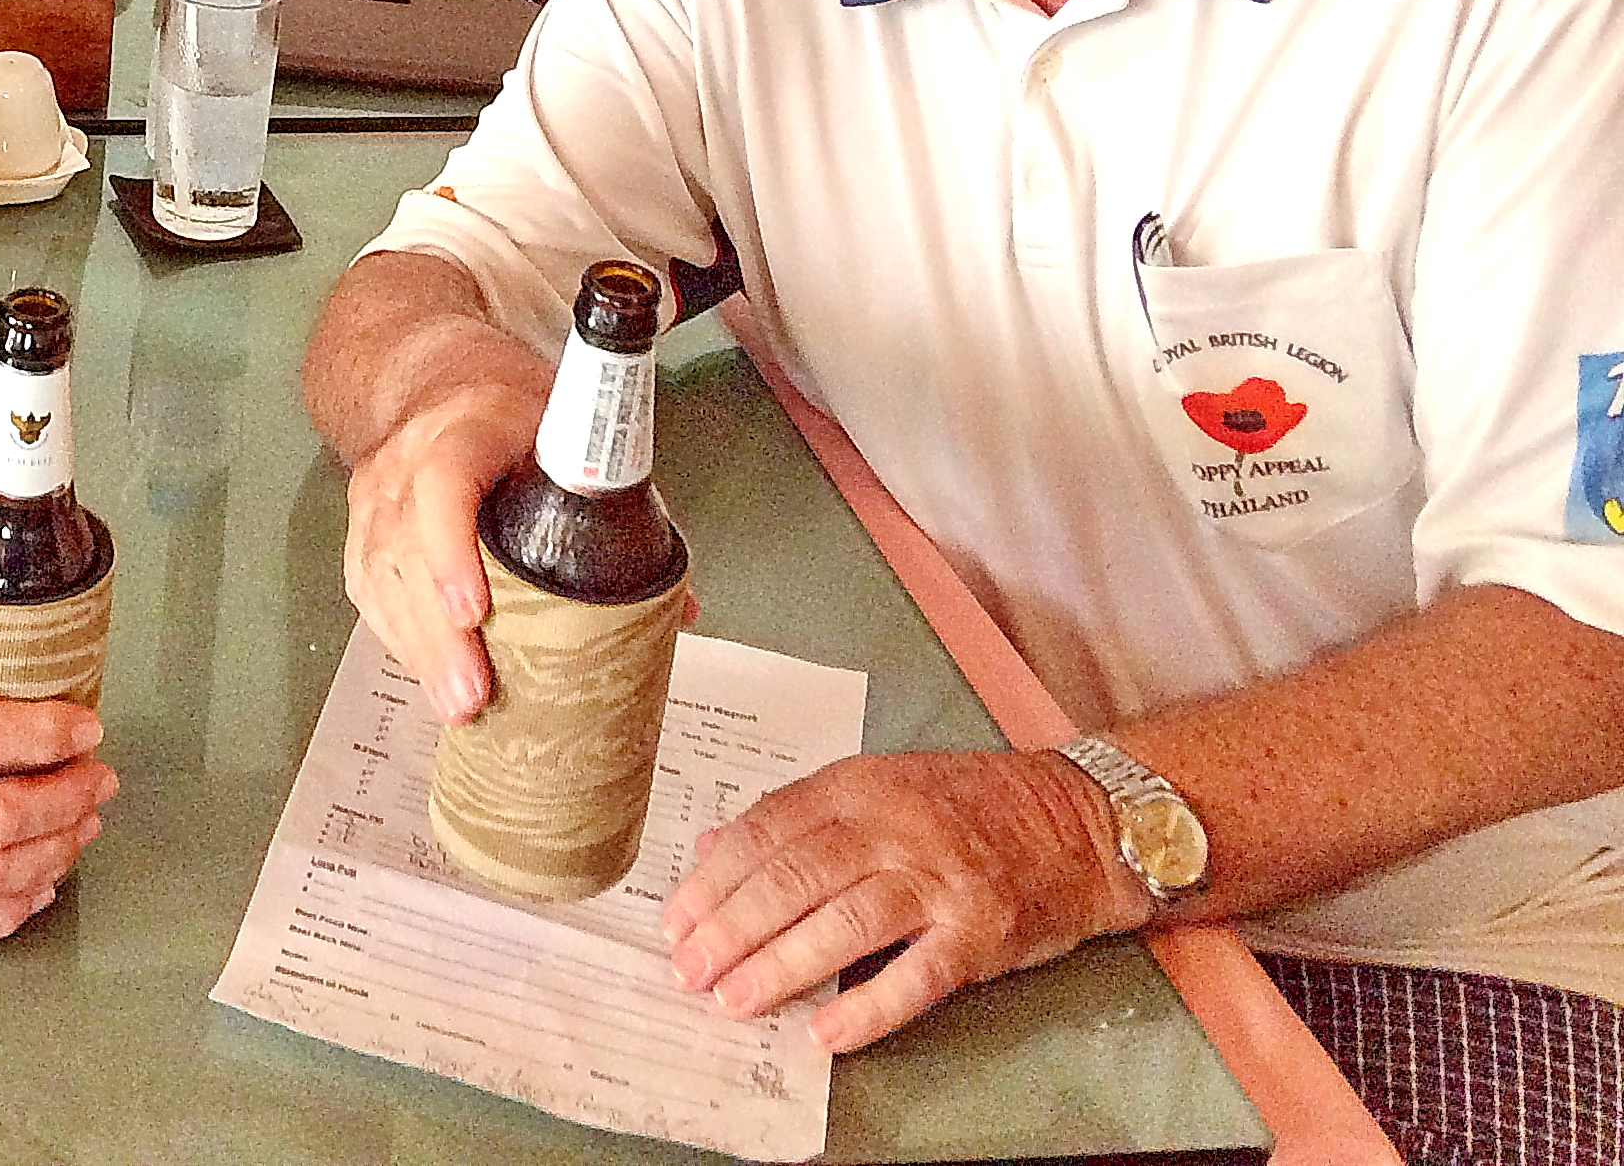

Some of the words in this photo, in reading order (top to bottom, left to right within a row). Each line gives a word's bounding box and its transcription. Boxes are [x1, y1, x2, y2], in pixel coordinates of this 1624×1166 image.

[1208, 332, 1279, 351] BRITISH
[1286, 343, 1349, 383] LEGION
[1249, 456, 1330, 479] APPEAL
[1201, 489, 1310, 519] THAILAND
